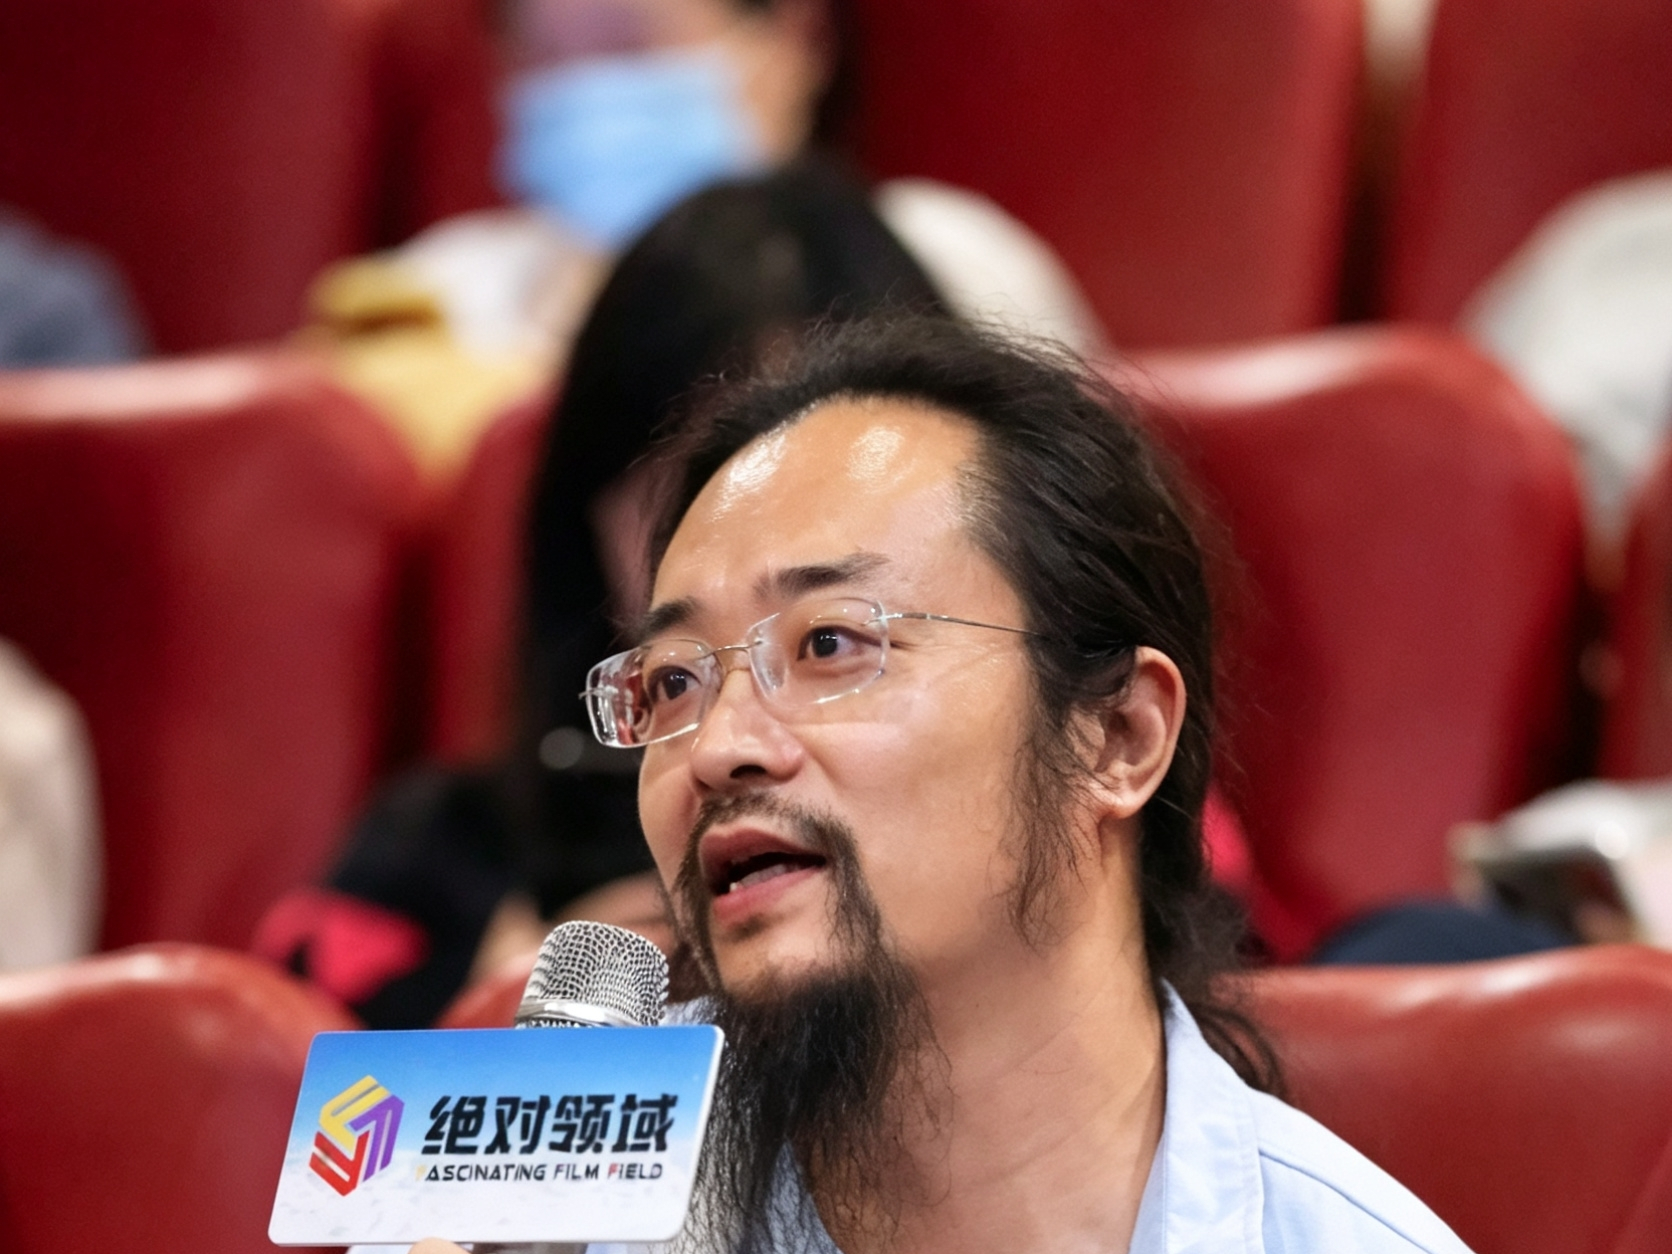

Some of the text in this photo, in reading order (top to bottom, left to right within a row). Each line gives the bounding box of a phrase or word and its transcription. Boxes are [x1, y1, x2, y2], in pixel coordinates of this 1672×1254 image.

[422, 1094, 678, 1155] 绝对领域
[553, 1163, 600, 1181] FILM
[607, 1162, 663, 1181] FIELD
